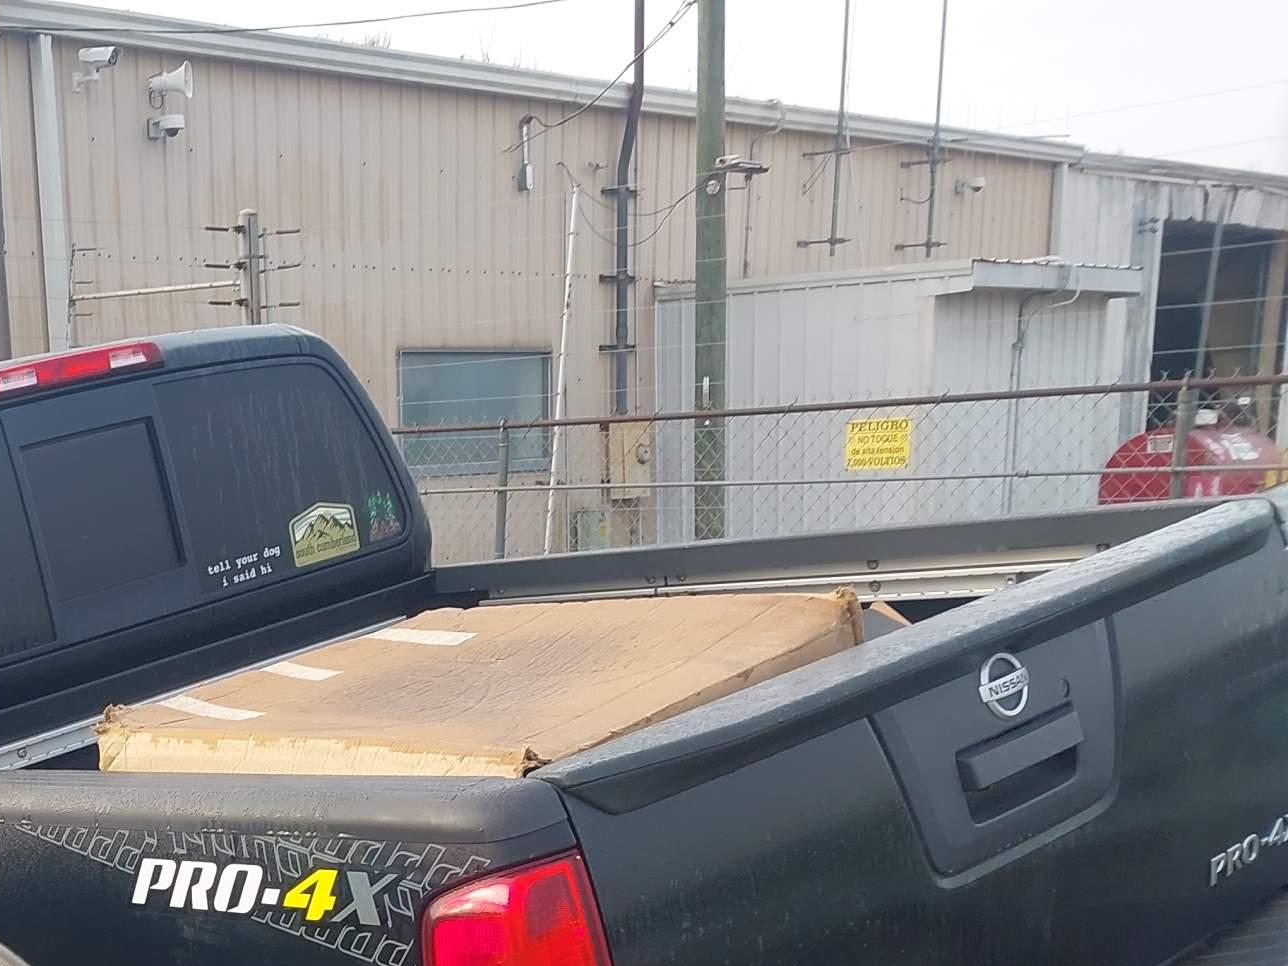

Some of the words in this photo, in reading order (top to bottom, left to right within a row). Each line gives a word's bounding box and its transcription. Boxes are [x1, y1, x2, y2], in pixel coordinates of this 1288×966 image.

[850, 419, 909, 432] PELIGRO
[857, 435, 870, 444] NO
[870, 433, 899, 444] TOQUE
[207, 557, 232, 576] tell
[235, 551, 260, 570] your
[263, 544, 281, 558] dog
[221, 575, 229, 588] i
[232, 568, 257, 584] said
[260, 561, 273, 575] hi
[988, 672, 1030, 698] NISSAN
[131, 857, 400, 927] PRO-4X
